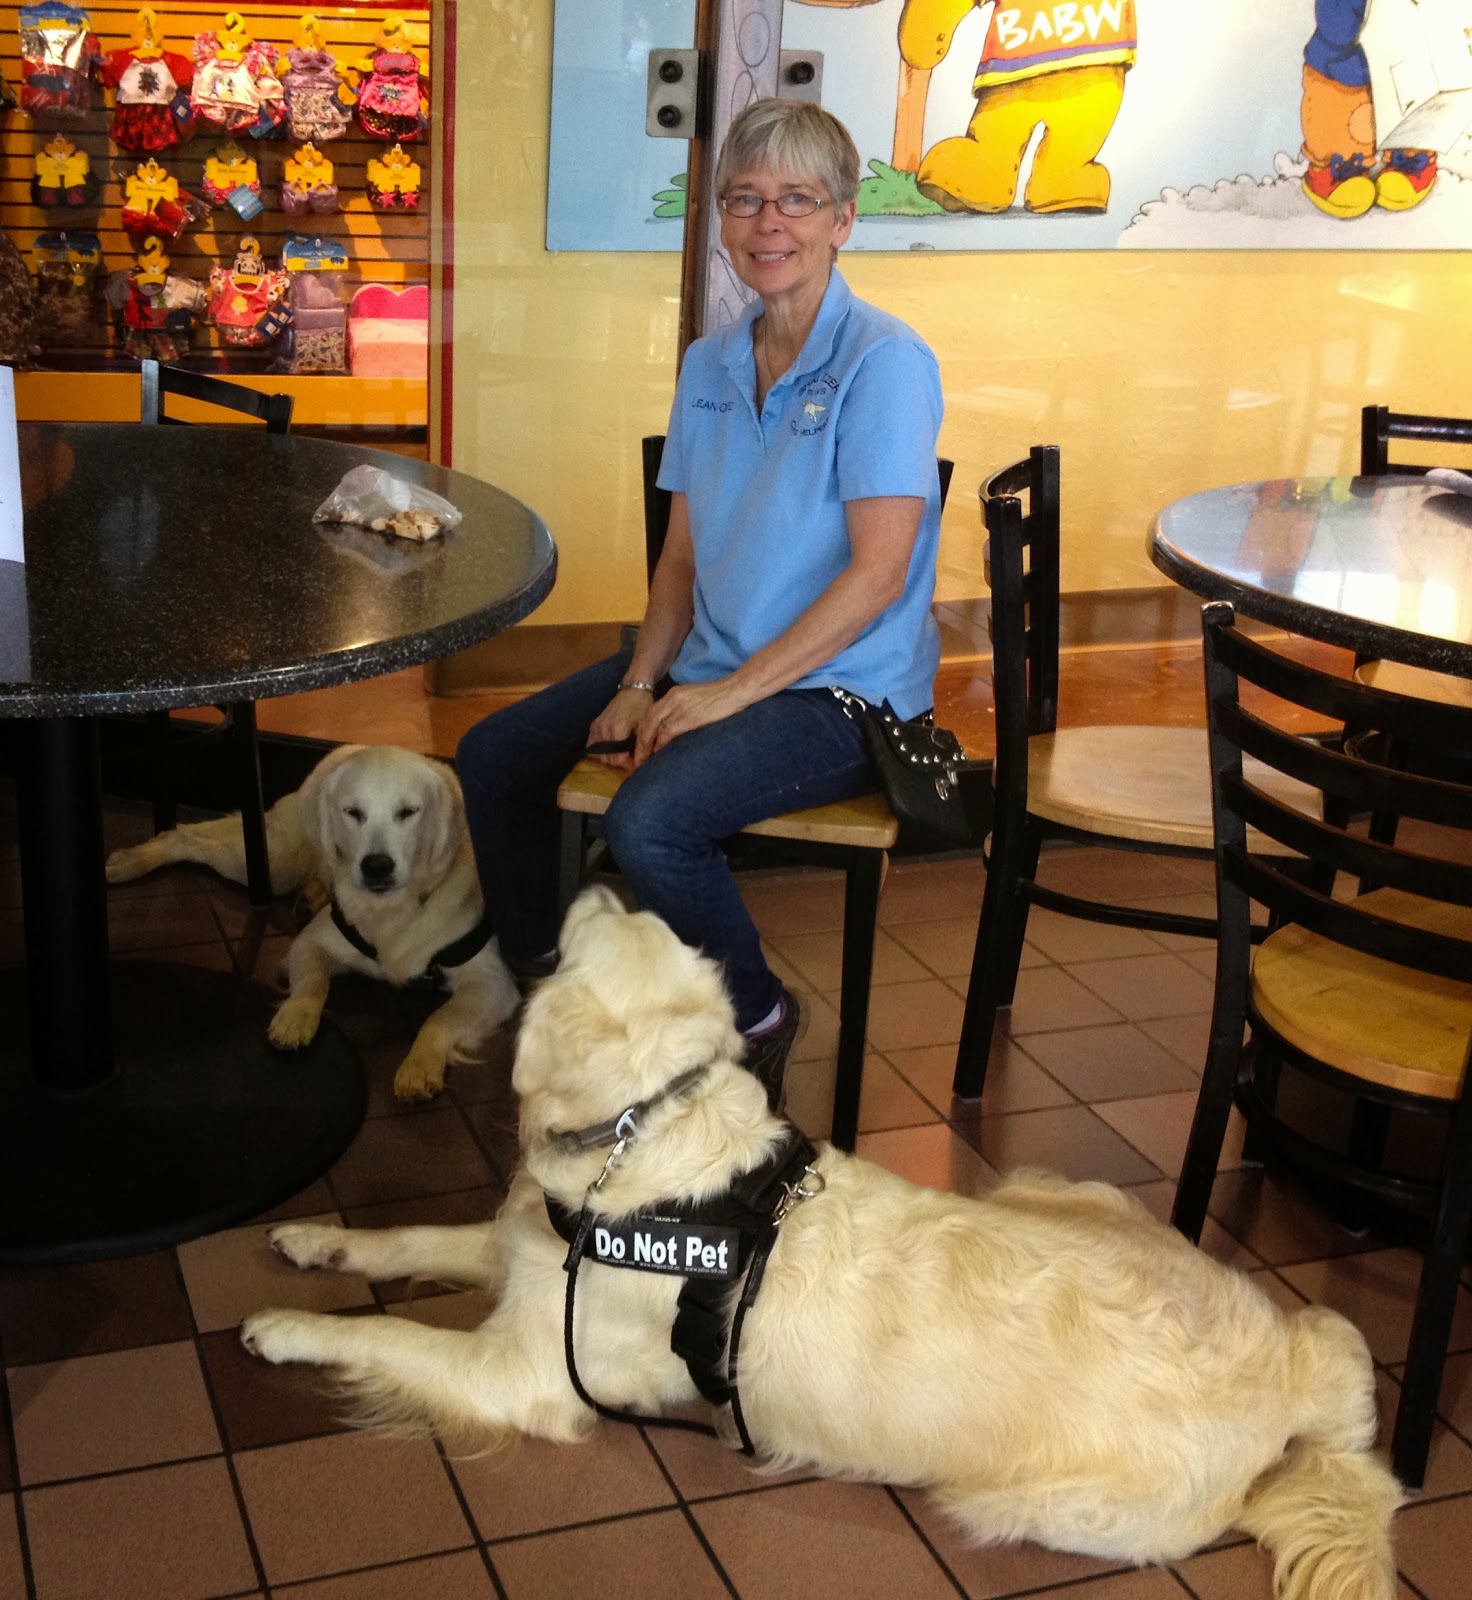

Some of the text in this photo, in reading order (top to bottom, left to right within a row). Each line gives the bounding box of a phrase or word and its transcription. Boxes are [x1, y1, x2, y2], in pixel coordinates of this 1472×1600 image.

[996, 1, 1124, 51] BABW
[595, 1227, 728, 1270] Do Not Pet
